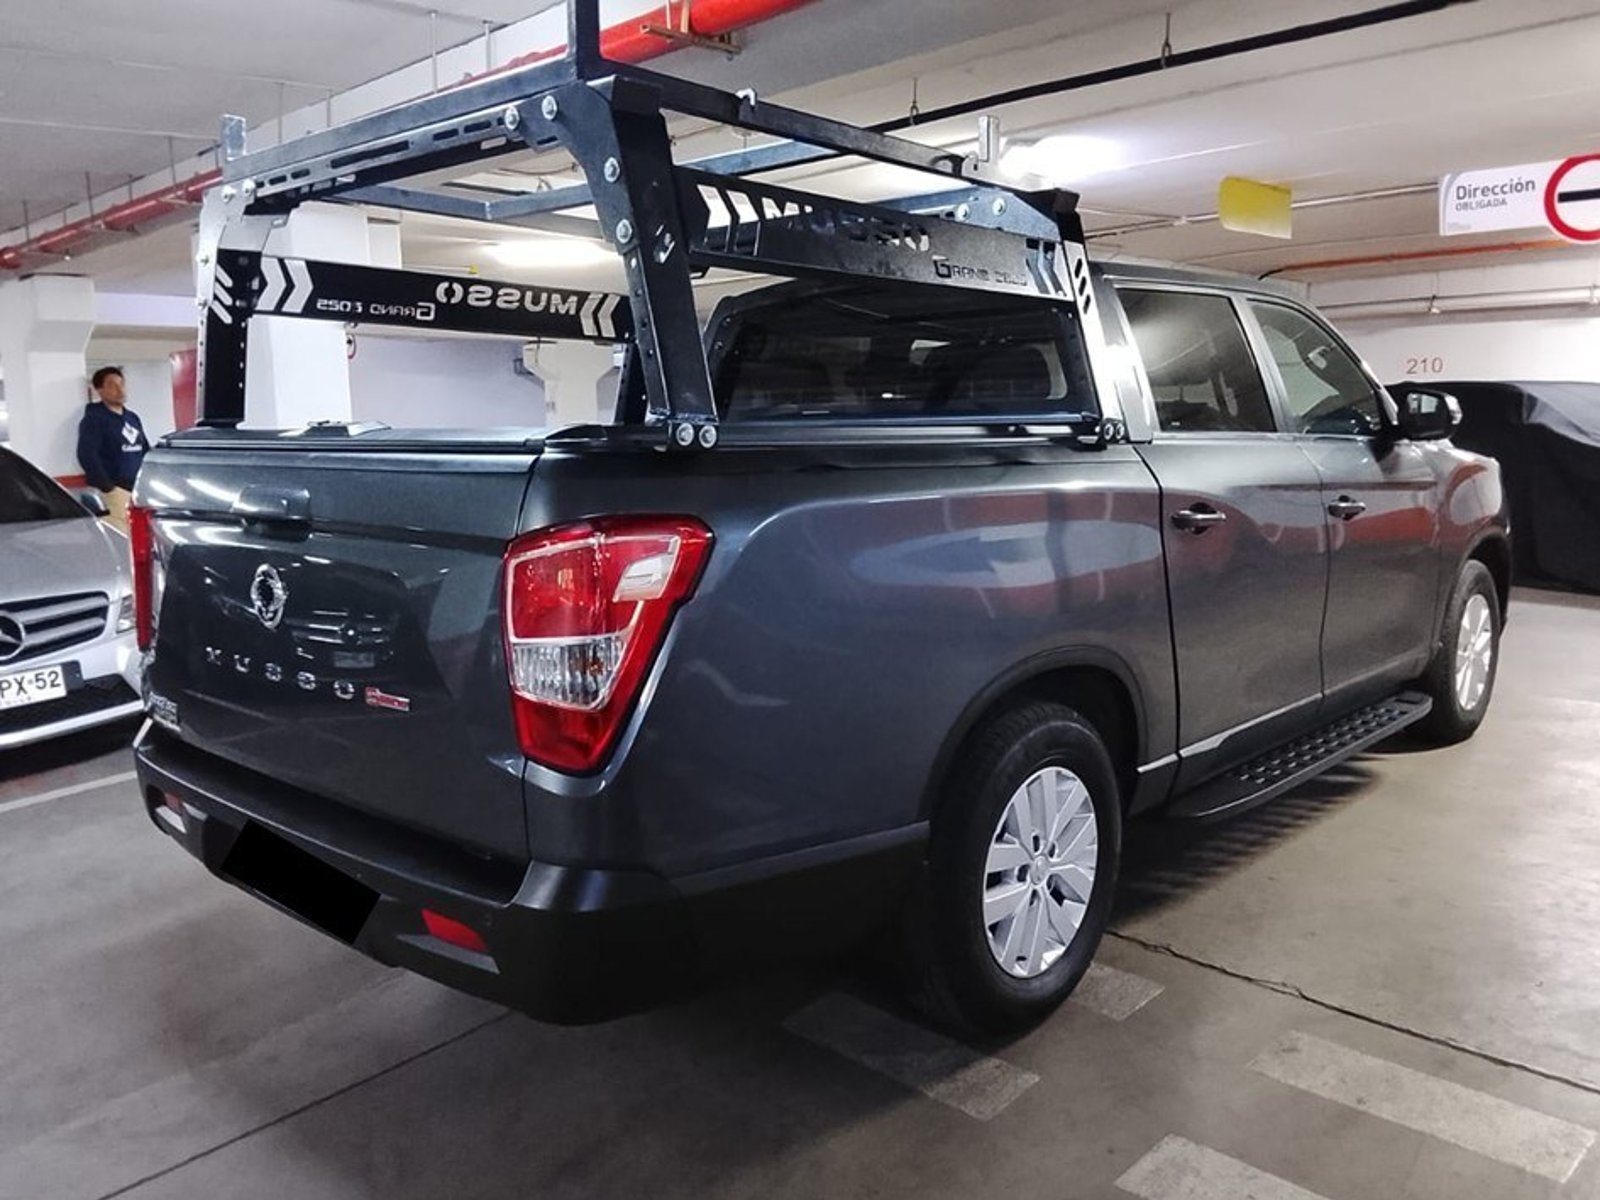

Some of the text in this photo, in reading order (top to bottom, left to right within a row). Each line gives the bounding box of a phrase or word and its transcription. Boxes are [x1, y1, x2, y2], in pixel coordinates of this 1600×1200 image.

[1456, 177, 1536, 200] Dirección
[1455, 197, 1508, 212] OBLIGADA
[1406, 357, 1443, 374] 210
